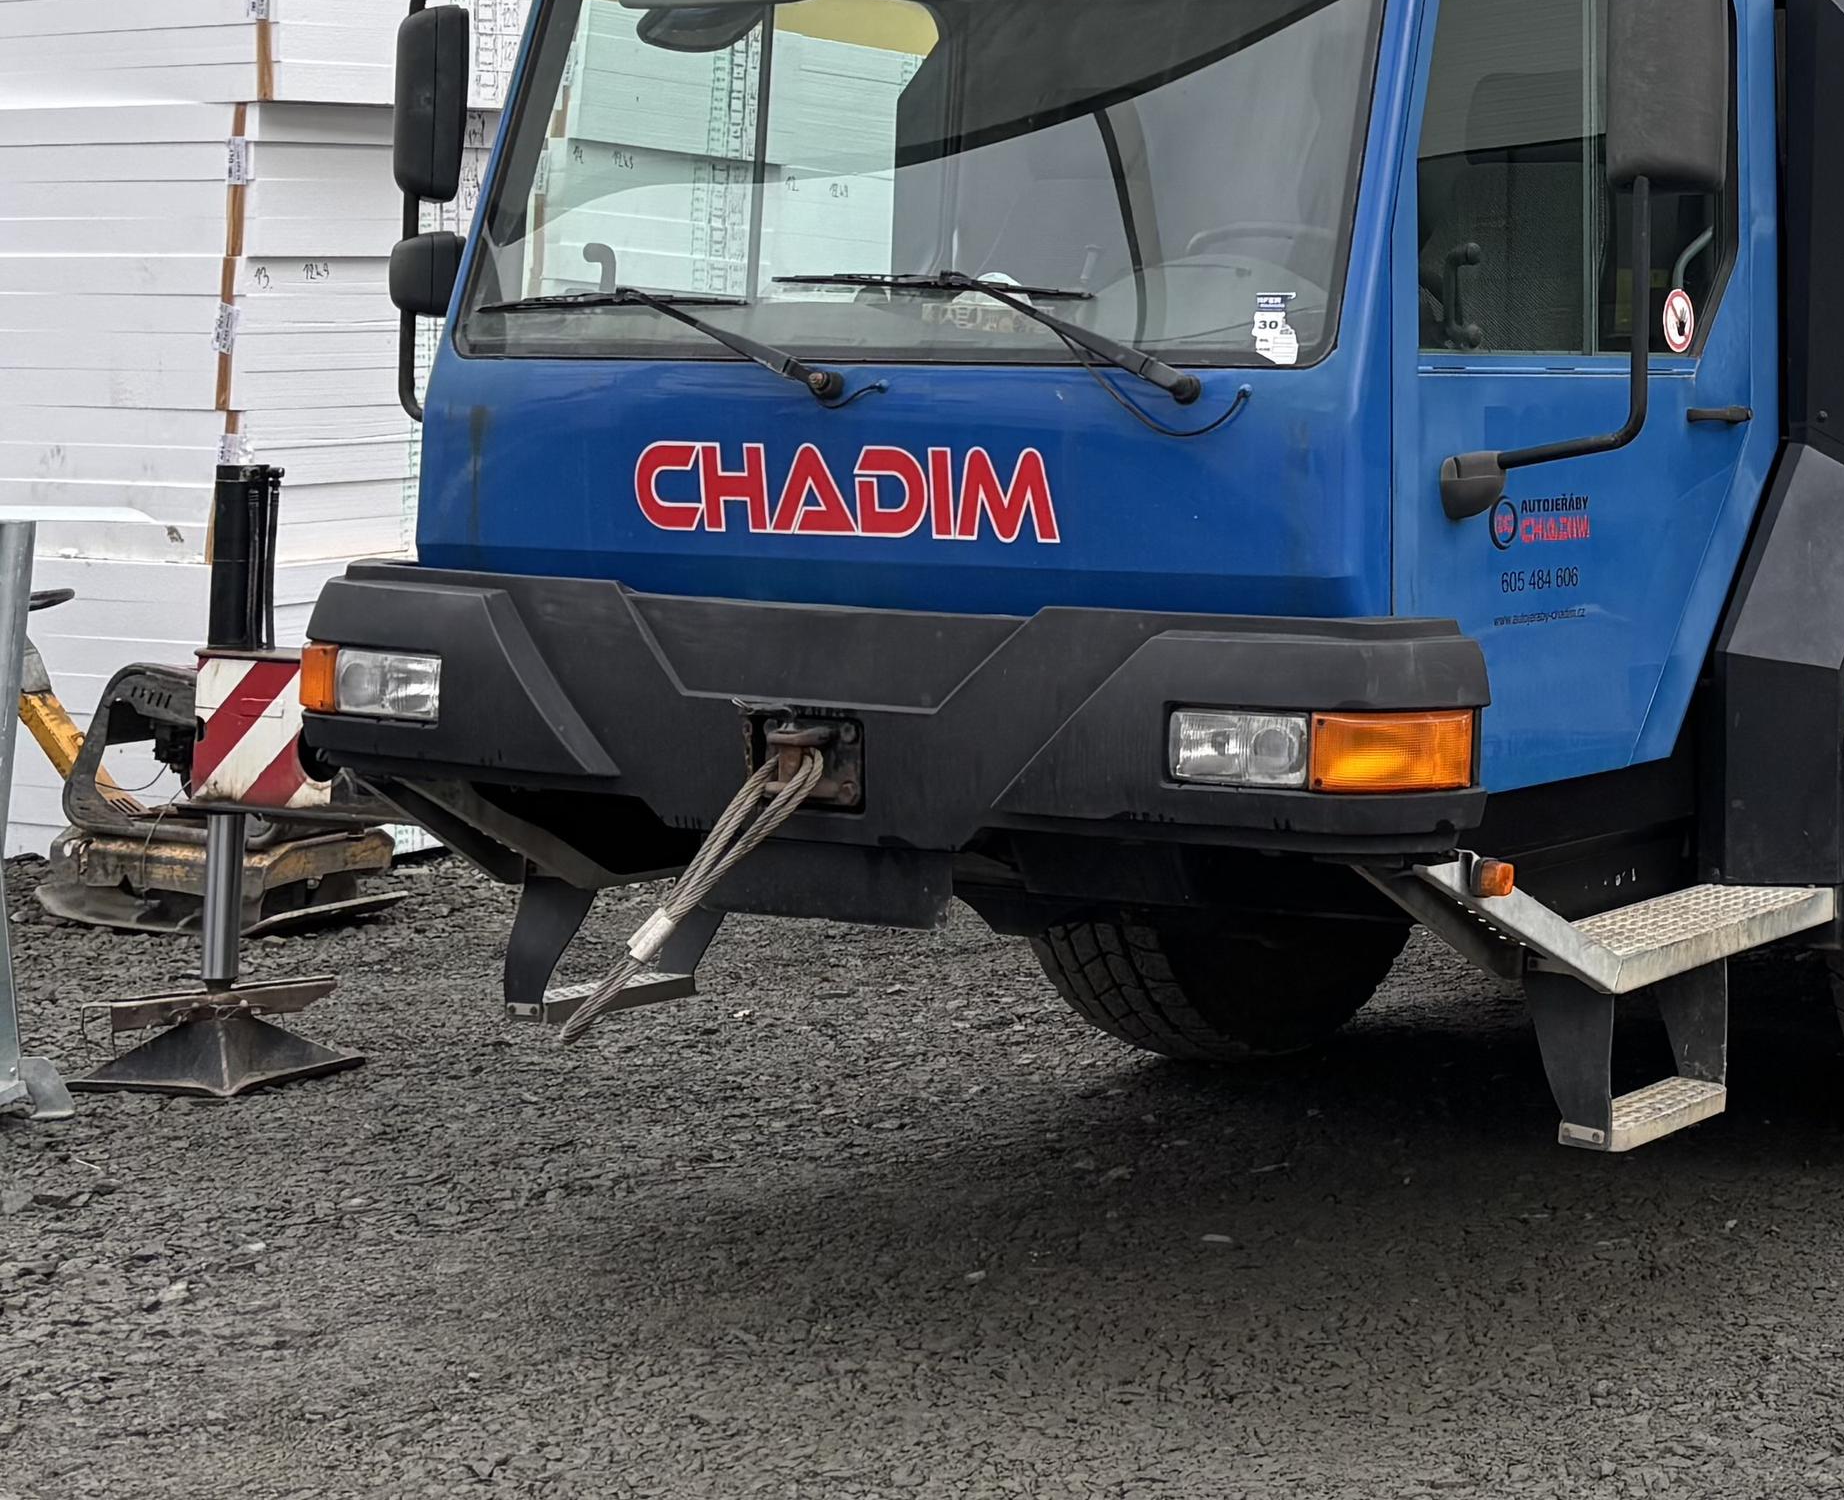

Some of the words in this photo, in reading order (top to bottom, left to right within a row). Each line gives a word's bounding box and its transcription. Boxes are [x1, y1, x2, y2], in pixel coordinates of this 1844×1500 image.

[1258, 320, 1278, 330] 30
[634, 440, 1061, 544] CHADIM
[1521, 493, 1588, 514] AUTOJEŘÁBY
[1501, 571, 1525, 593] 605
[1528, 569, 1551, 589] 484
[1555, 566, 1579, 587] 606
